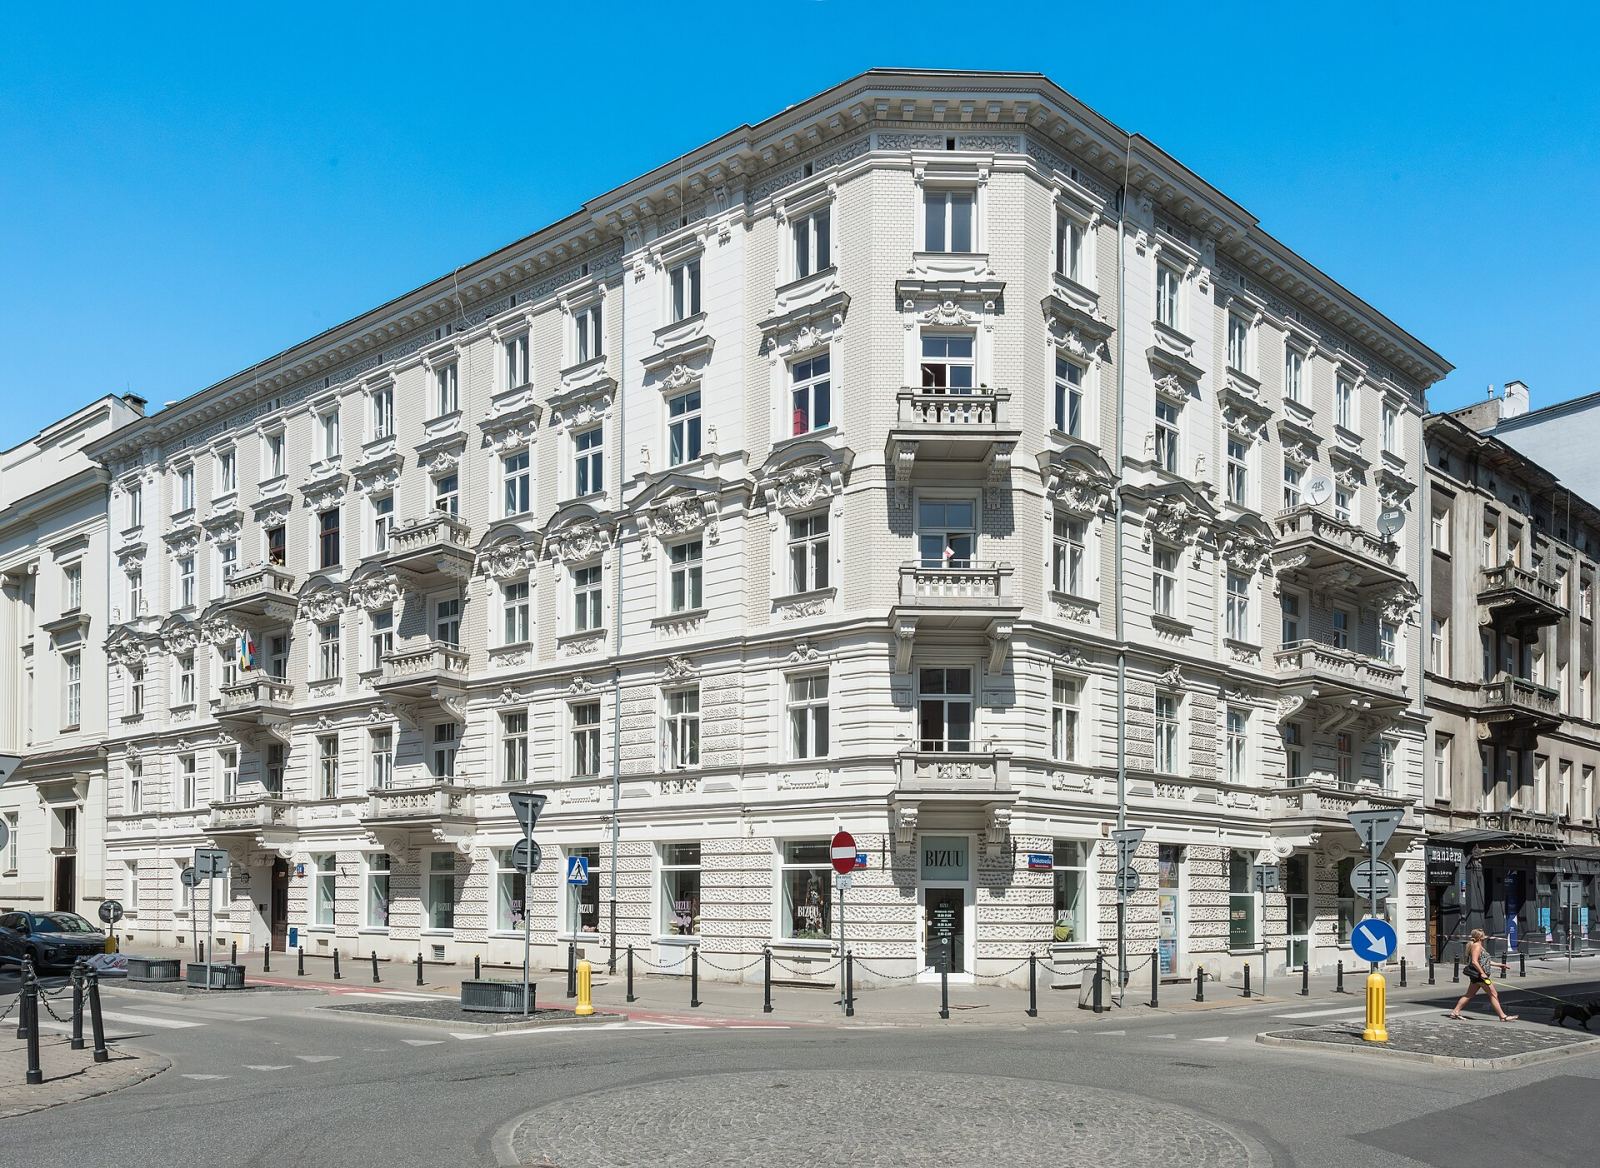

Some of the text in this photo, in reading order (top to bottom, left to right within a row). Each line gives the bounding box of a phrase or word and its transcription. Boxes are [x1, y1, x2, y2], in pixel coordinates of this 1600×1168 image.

[925, 850, 964, 867] BIZUU
[577, 903, 594, 913] BIZUU
[797, 905, 818, 917] BIZUU
